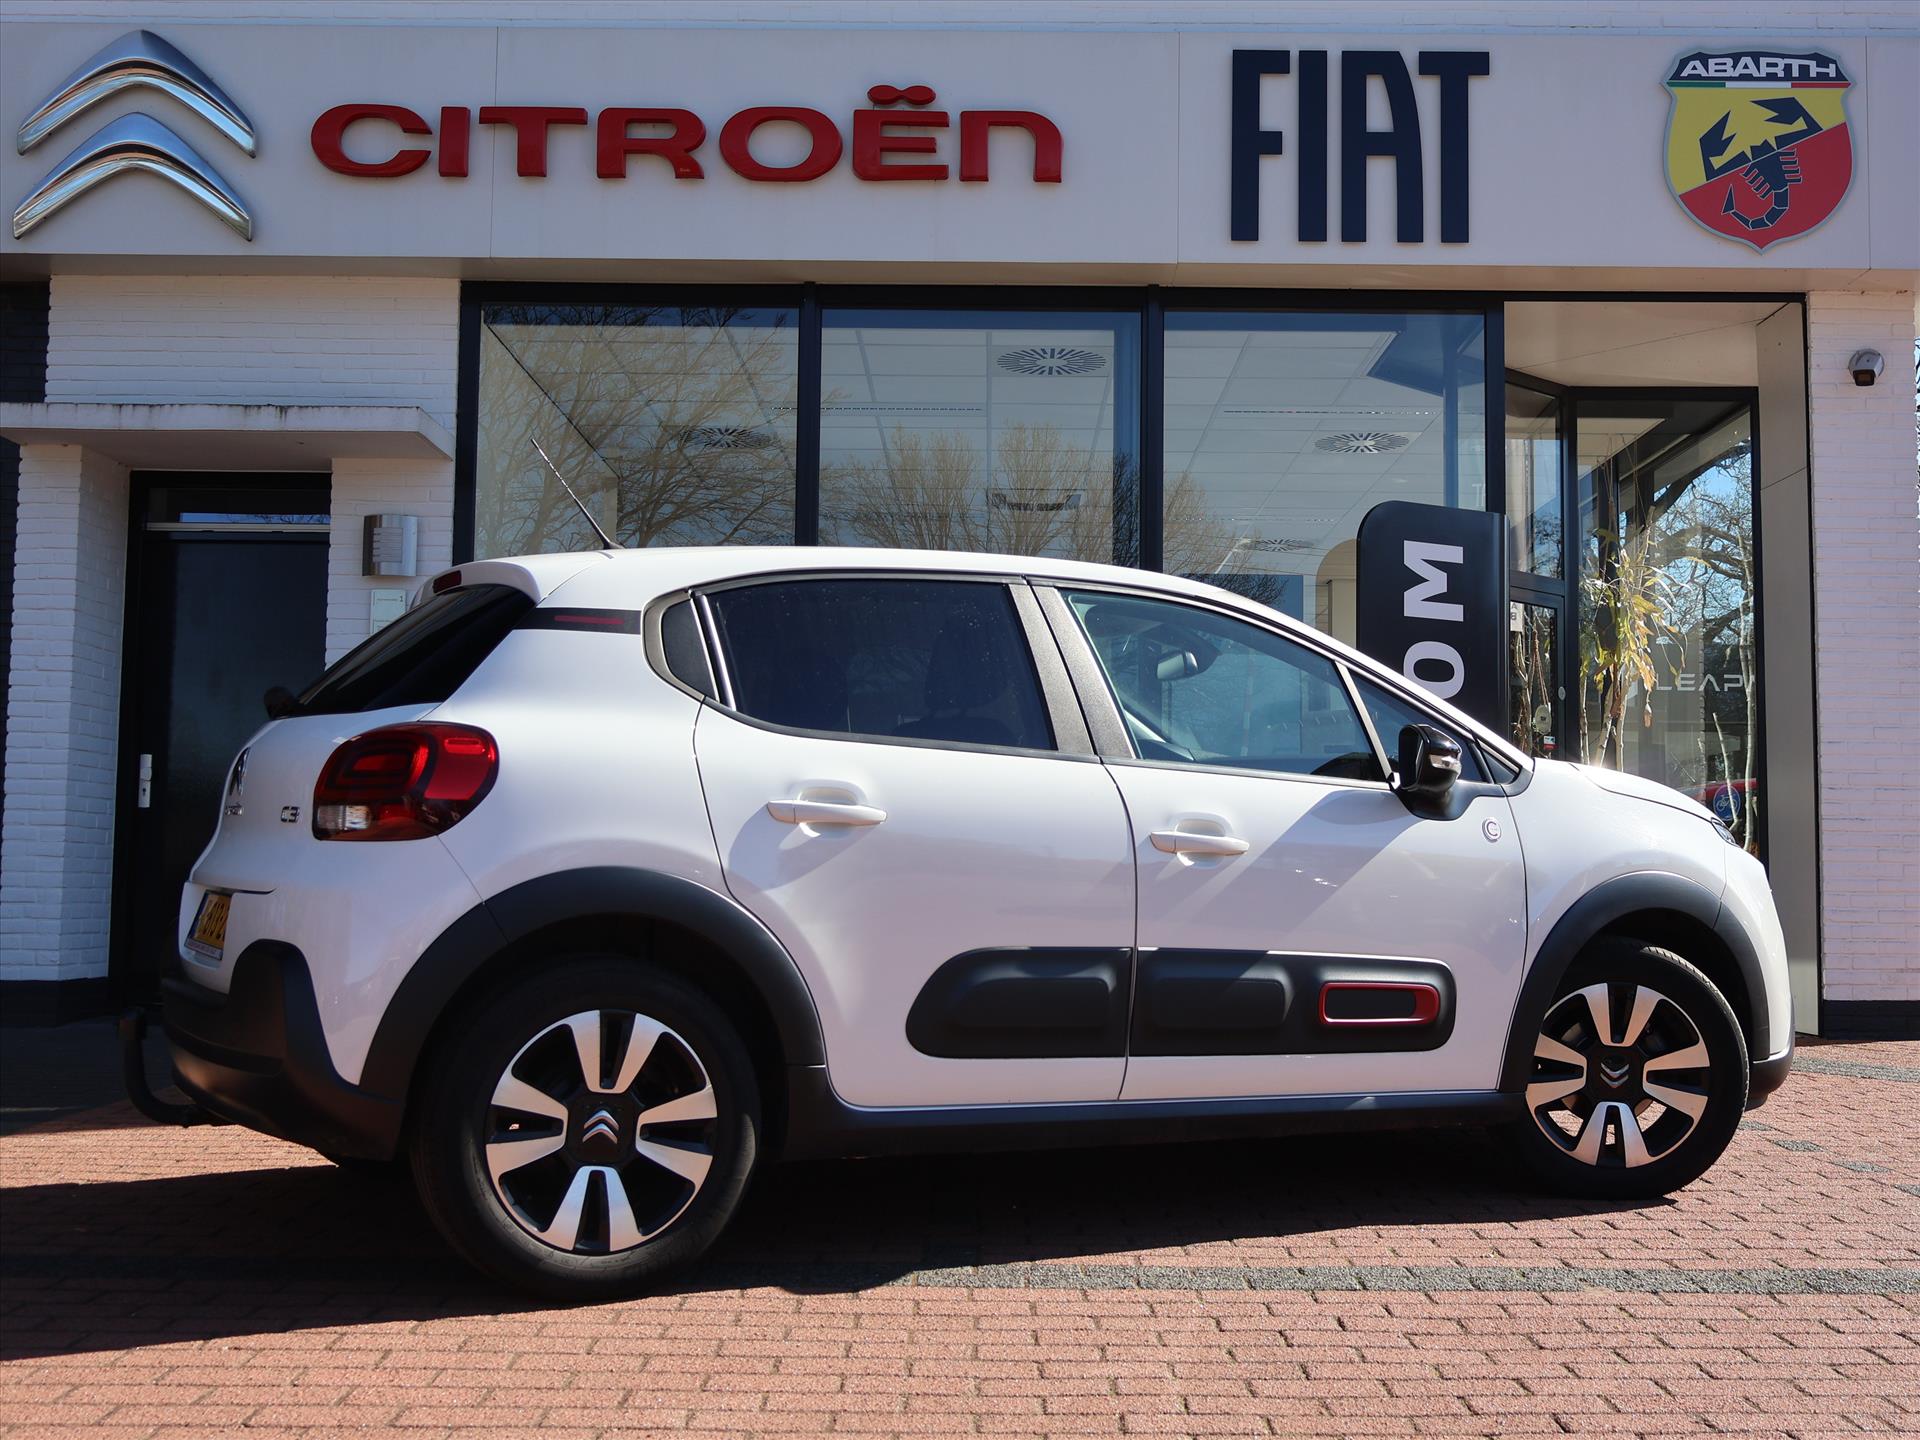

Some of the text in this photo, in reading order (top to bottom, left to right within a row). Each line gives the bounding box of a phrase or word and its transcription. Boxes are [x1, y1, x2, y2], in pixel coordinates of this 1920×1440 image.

[1680, 56, 1837, 78] ABARTH
[1230, 50, 1490, 243] FIAT
[281, 806, 301, 823] C3
